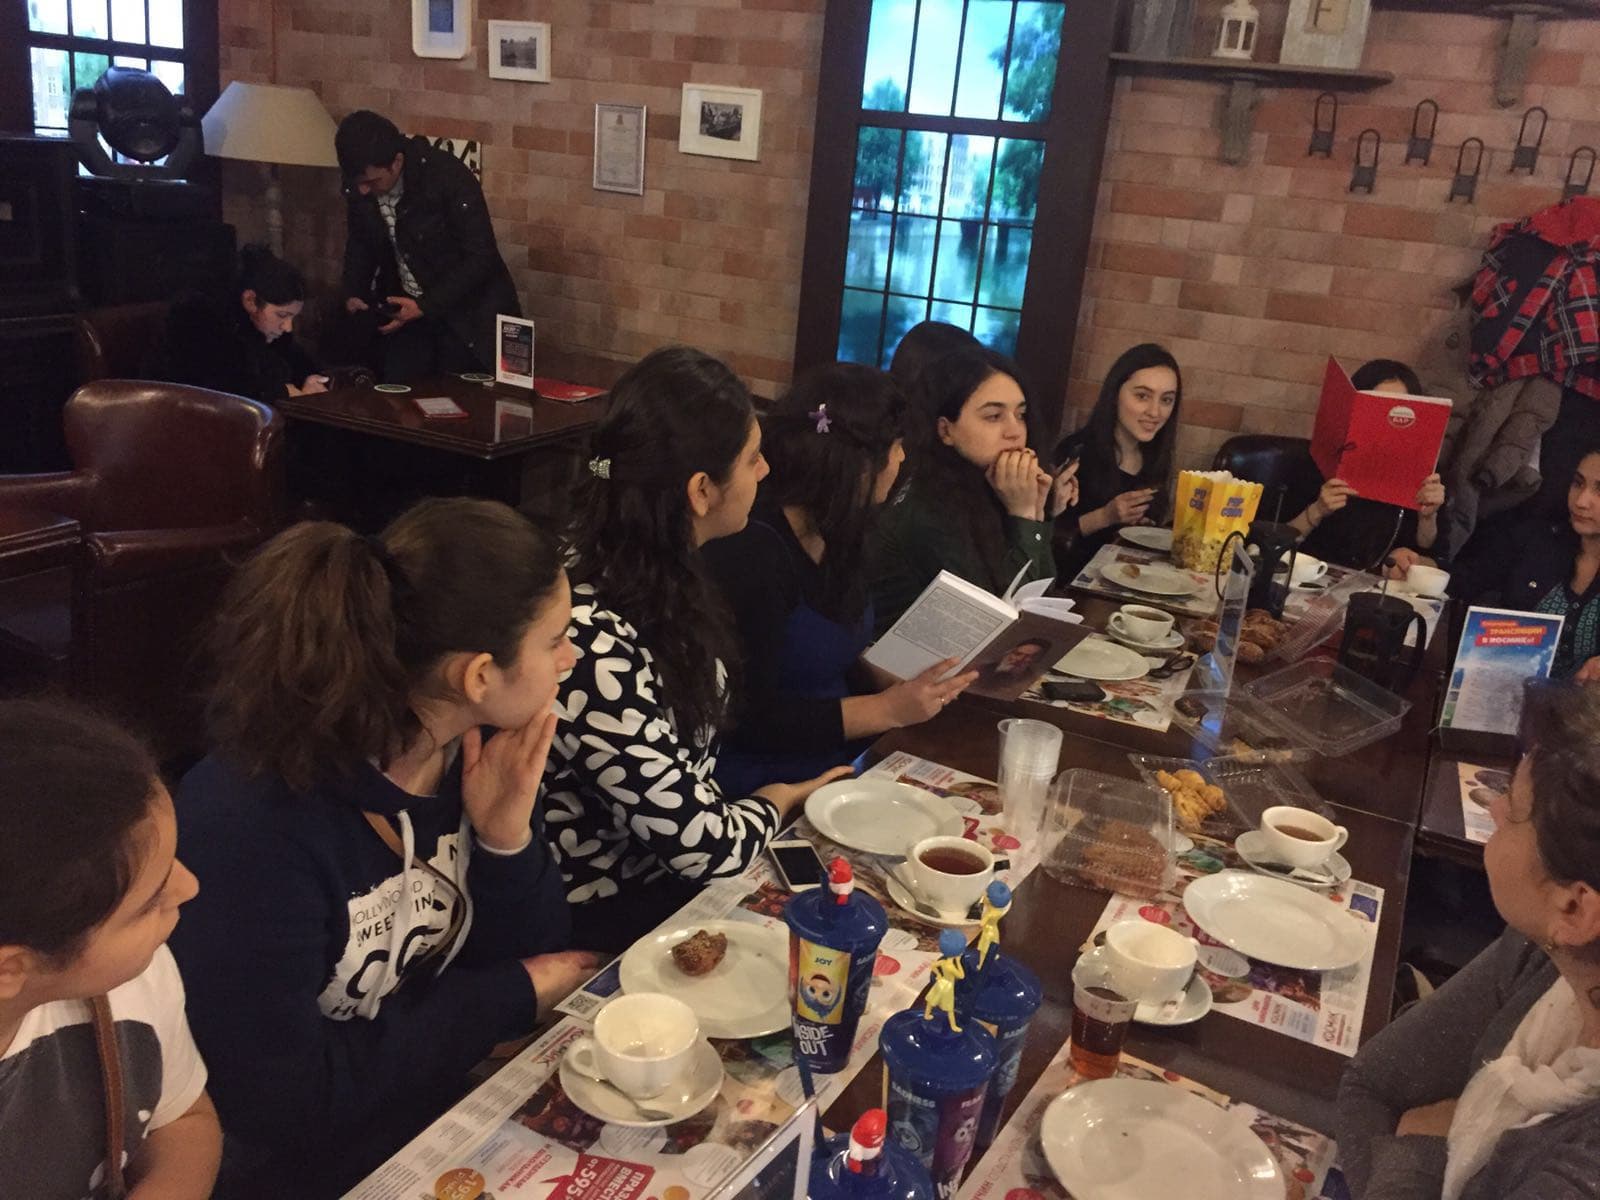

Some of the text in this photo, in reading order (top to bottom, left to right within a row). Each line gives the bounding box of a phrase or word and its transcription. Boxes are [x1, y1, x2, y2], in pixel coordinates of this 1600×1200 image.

[815, 957, 832, 966] JOY
[800, 1039, 827, 1056] OUT
[566, 1167, 598, 1197] 595
[602, 1166, 632, 1200] ВМЕСТ
